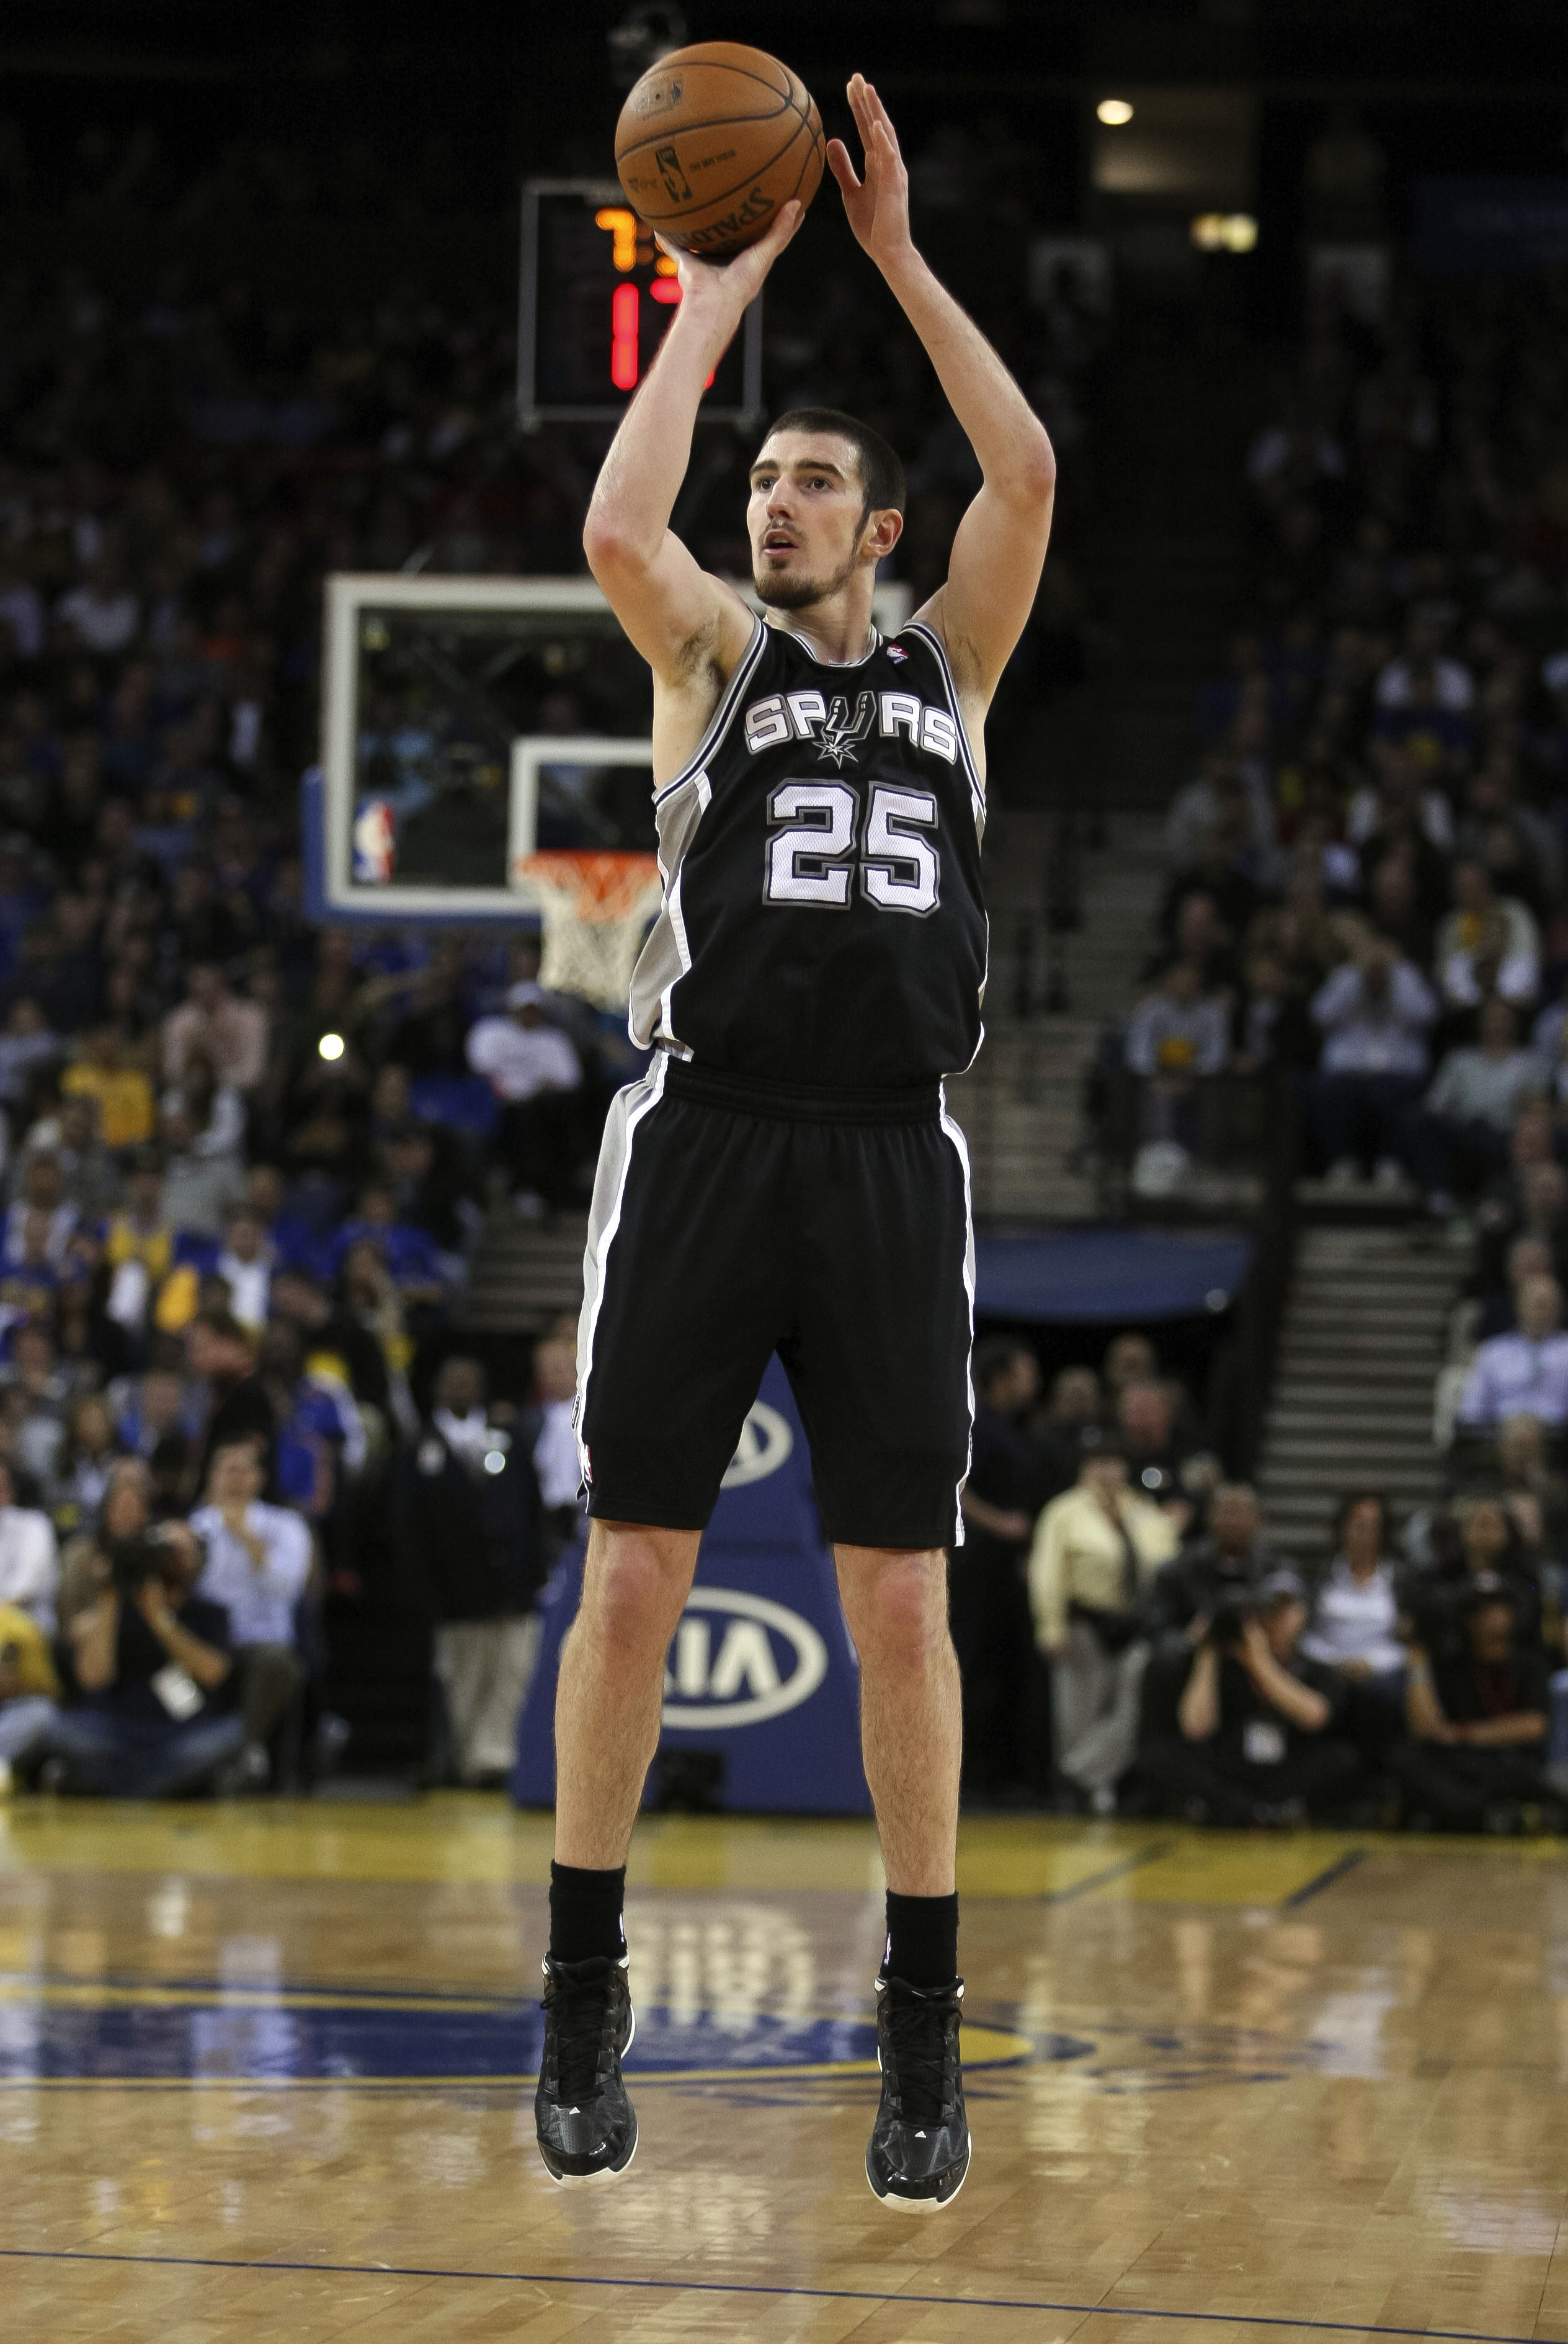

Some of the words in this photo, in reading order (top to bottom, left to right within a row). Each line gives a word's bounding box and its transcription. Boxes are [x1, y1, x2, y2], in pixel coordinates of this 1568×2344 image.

[744, 690, 958, 769] SPURS
[762, 778, 941, 919] 25
[663, 1616, 783, 1700] IA
